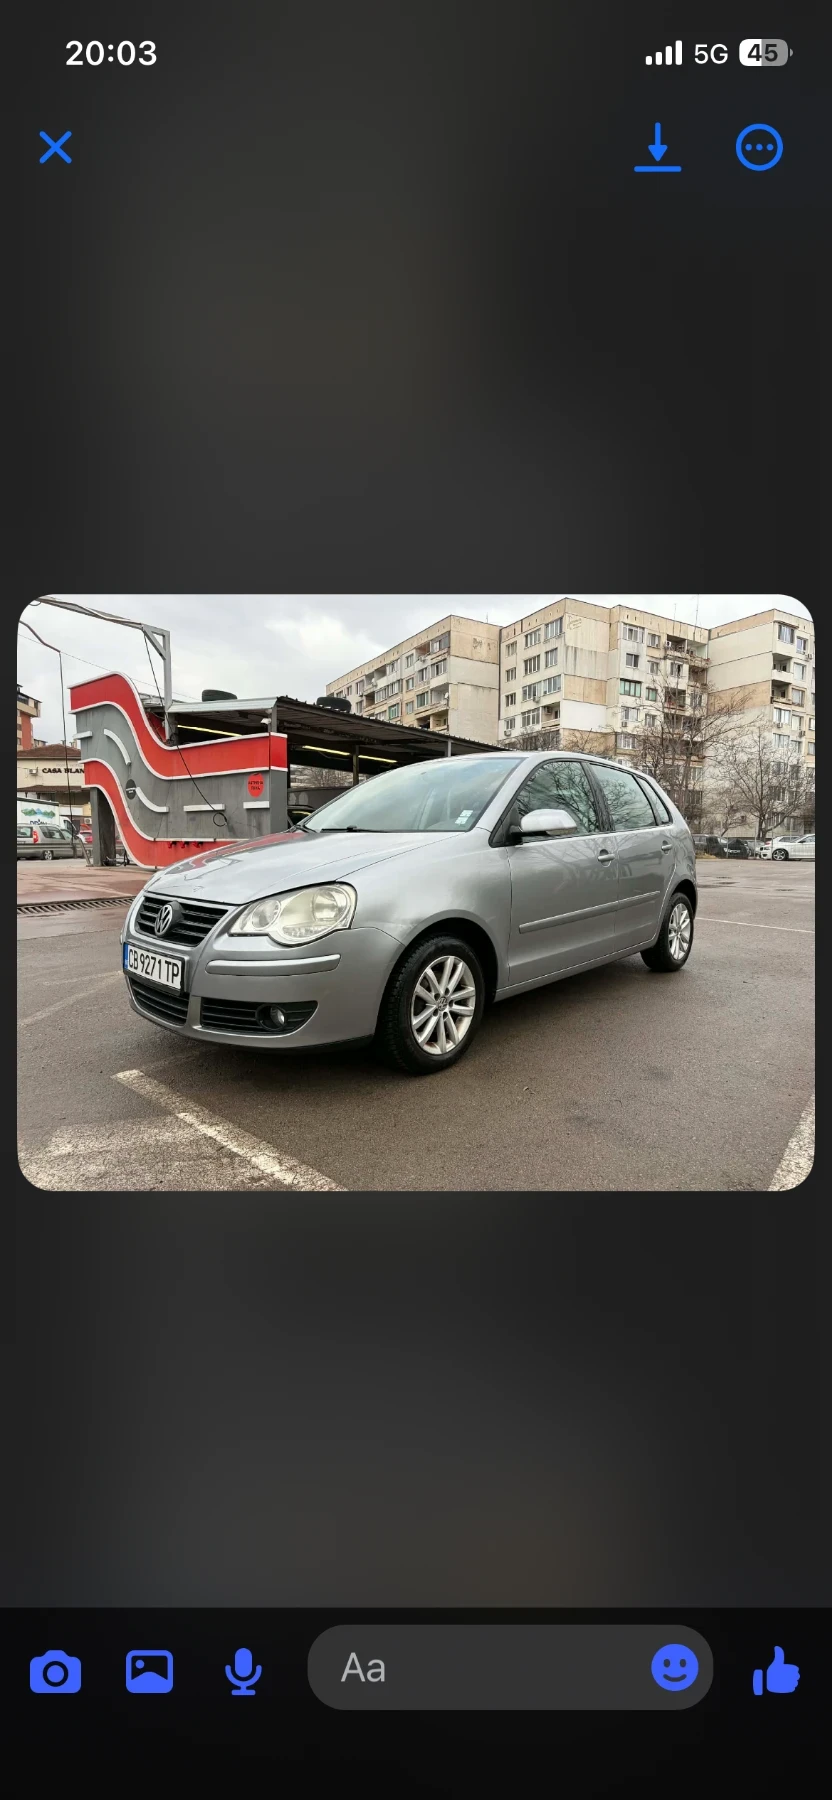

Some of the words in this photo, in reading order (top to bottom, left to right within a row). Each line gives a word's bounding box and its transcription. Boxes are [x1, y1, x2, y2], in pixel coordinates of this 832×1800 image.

[128, 948, 139, 969] CB
[140, 953, 161, 979] 9271
[164, 960, 179, 983] TP
